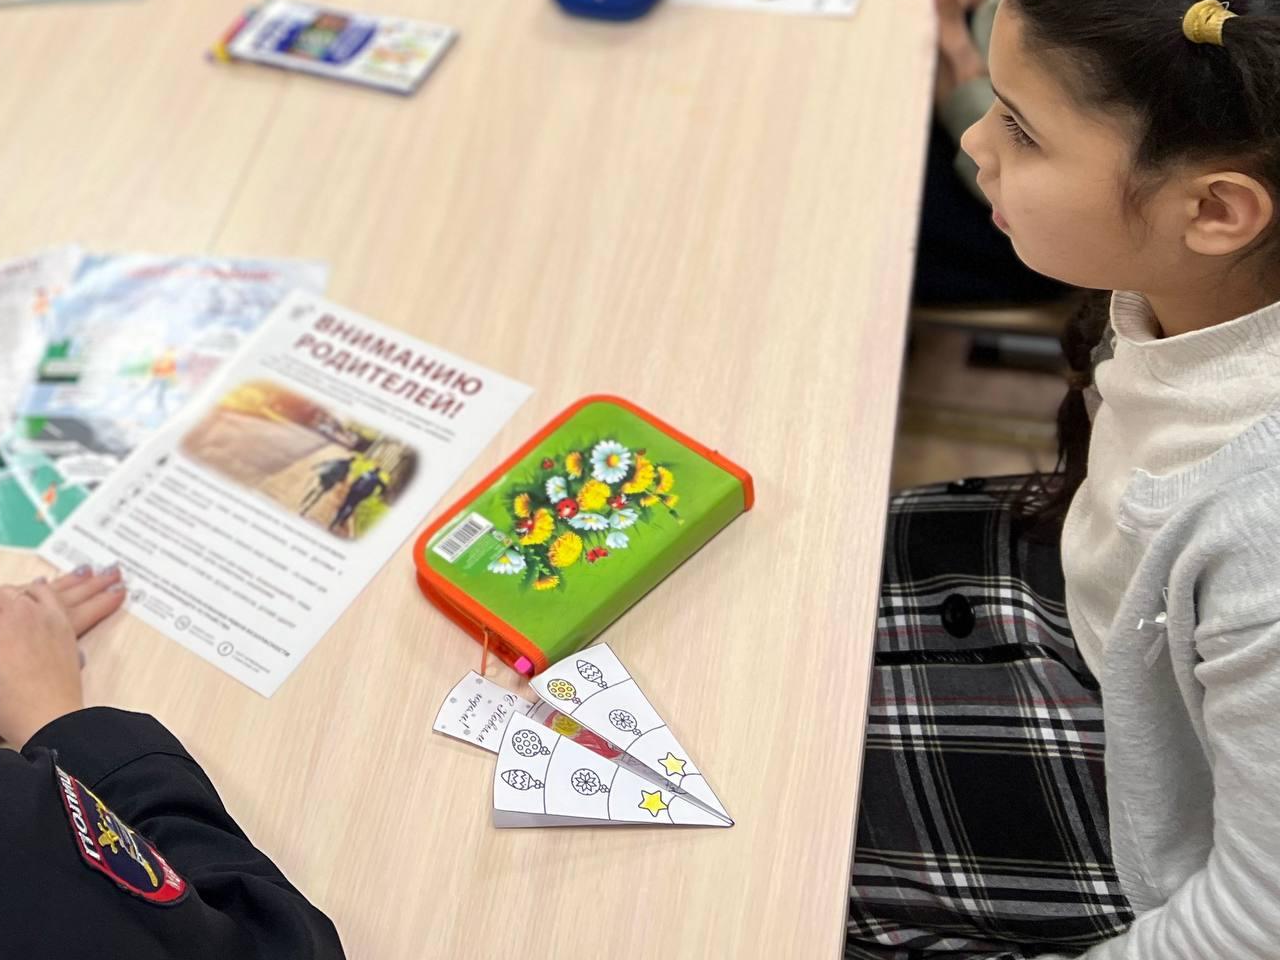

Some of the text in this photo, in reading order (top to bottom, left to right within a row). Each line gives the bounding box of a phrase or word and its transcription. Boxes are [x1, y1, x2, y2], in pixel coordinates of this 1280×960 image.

[294, 333, 465, 419] РОДИТЕЛЕЙ!
[314, 313, 483, 396] ВНИМАНИЮ
[475, 693, 518, 743] С Новым
[55, 765, 101, 861] ПОЛИЦ
